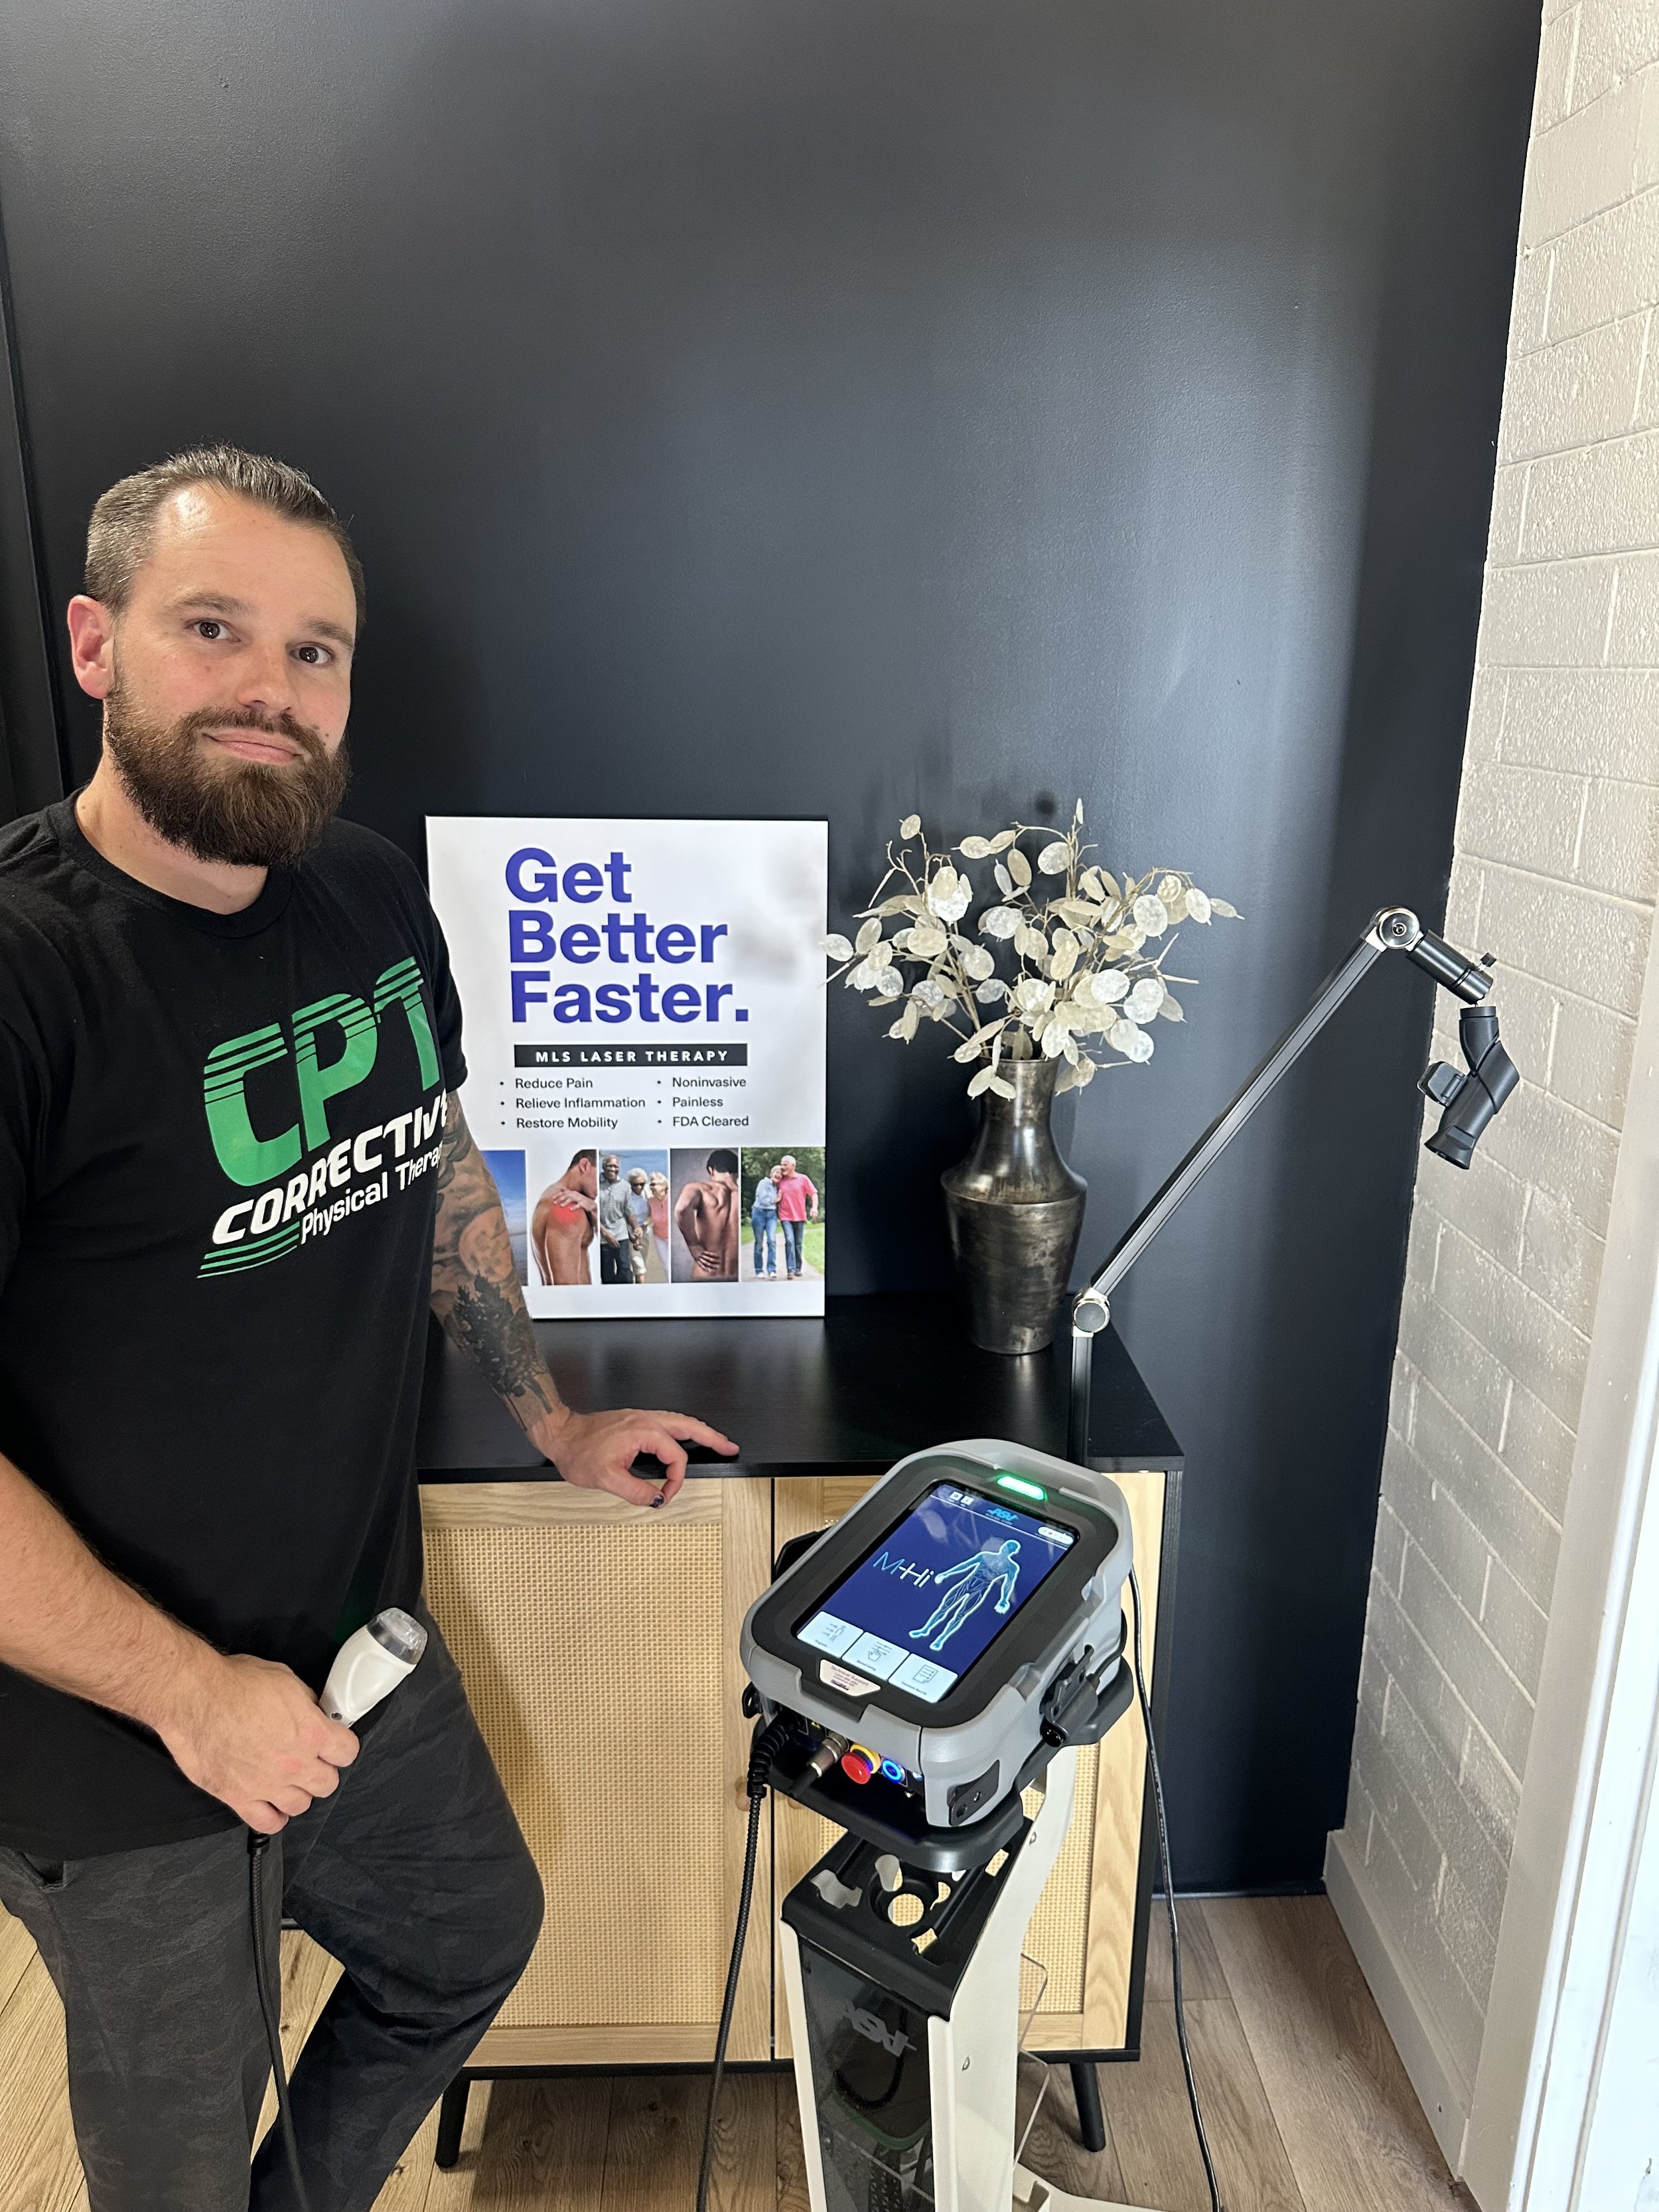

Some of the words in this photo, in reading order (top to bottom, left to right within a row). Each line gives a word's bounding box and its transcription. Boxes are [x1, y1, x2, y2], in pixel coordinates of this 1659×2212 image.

[505, 848, 632, 904] Get
[508, 909, 728, 964] Better
[511, 970, 749, 1023] Faster.
[536, 1051, 571, 1063] MLS
[581, 1051, 636, 1063] LASER
[645, 1050, 729, 1062] THERAPY
[204, 956, 440, 1186] CPT
[515, 1078, 563, 1089] Reduce
[566, 1078, 593, 1088] Pain
[672, 1076, 747, 1087] Noninvasive
[516, 1098, 561, 1109] Relieve
[564, 1097, 646, 1108] Inflammation
[672, 1096, 723, 1107] Painless
[516, 1118, 564, 1128] Restore
[568, 1117, 618, 1130] Mobility
[673, 1116, 699, 1127] FDA
[701, 1116, 749, 1126] Cleared
[301, 1172, 388, 1244] Physical
[395, 1140, 443, 1191] Therap
